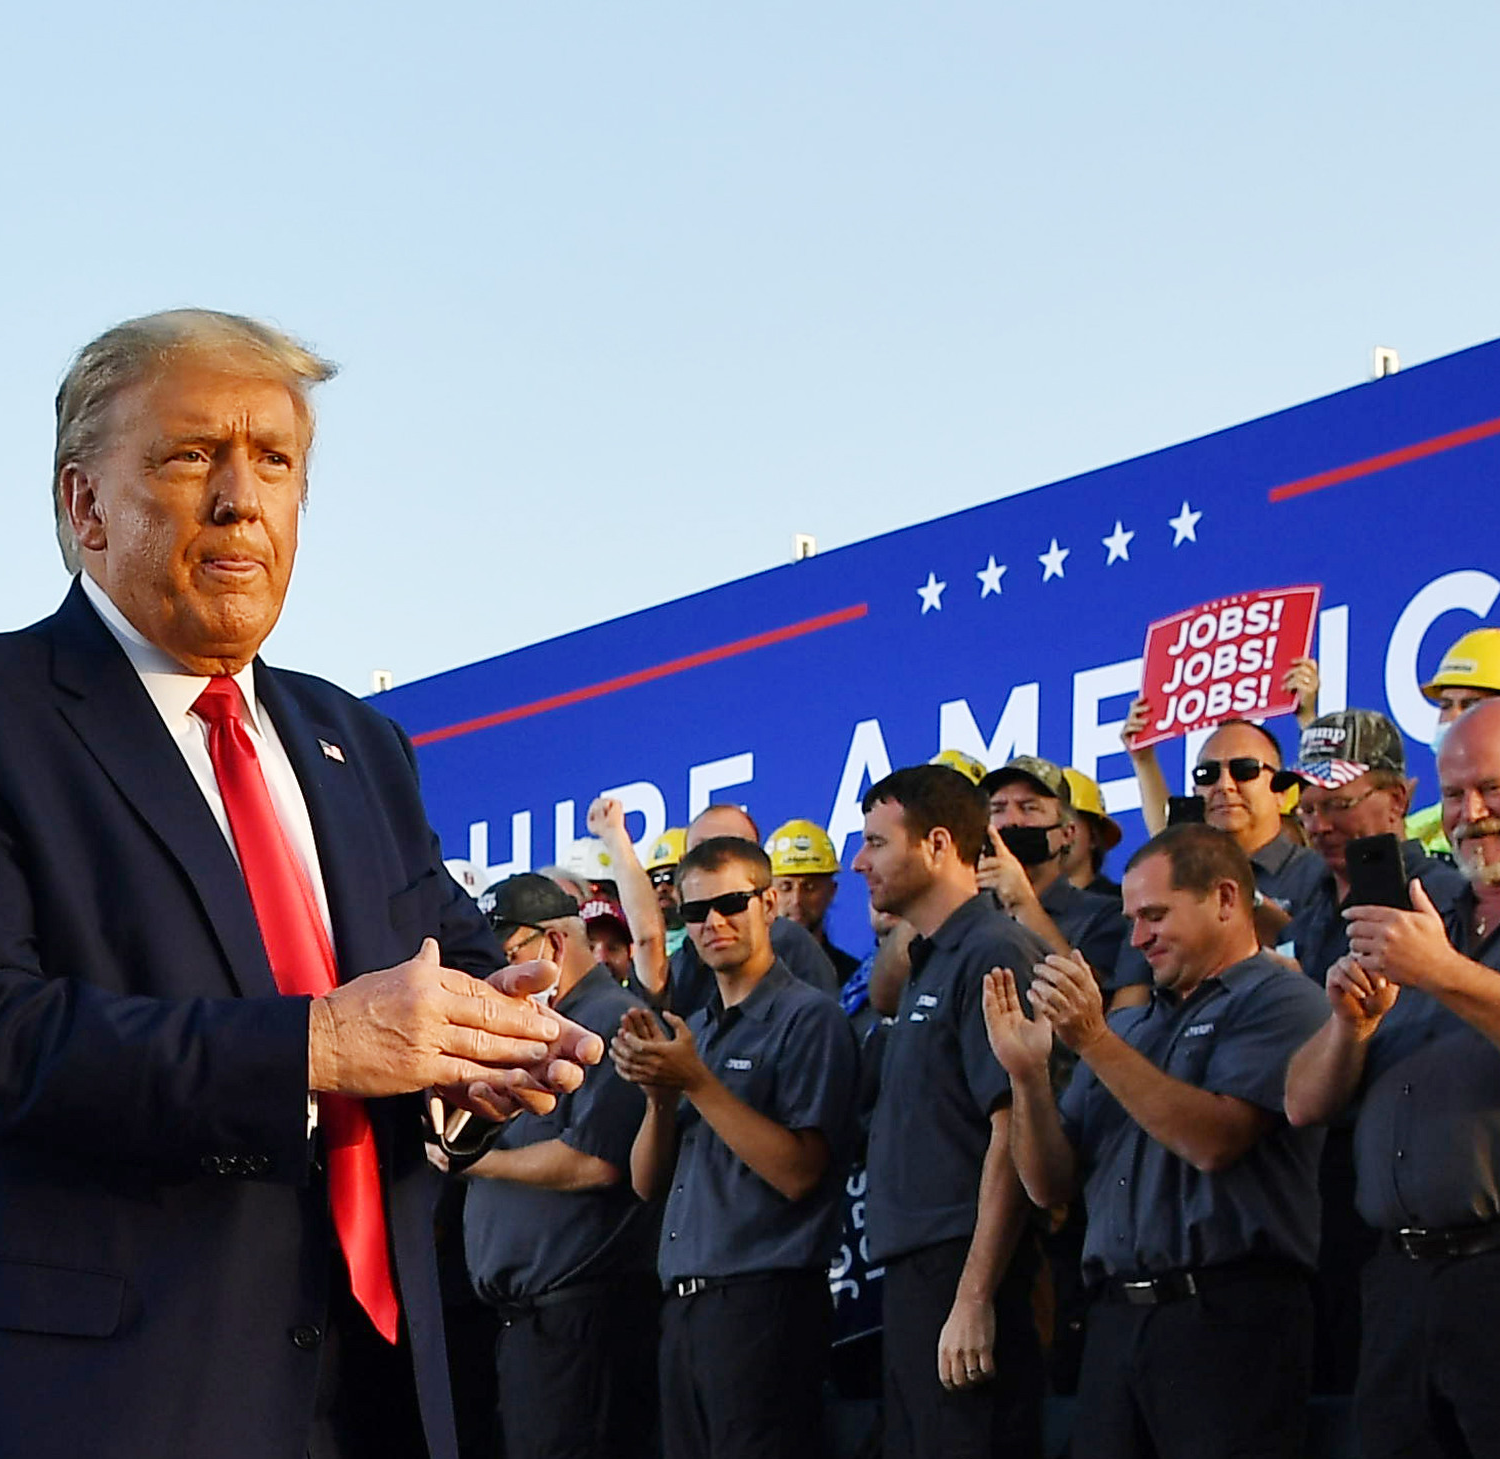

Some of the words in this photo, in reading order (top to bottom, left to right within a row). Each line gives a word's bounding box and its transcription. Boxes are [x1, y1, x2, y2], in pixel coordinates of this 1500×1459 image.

[1167, 599, 1284, 655] JOBS!
[1162, 636, 1277, 693] JOBS!
[1155, 674, 1271, 730] JOBS!
